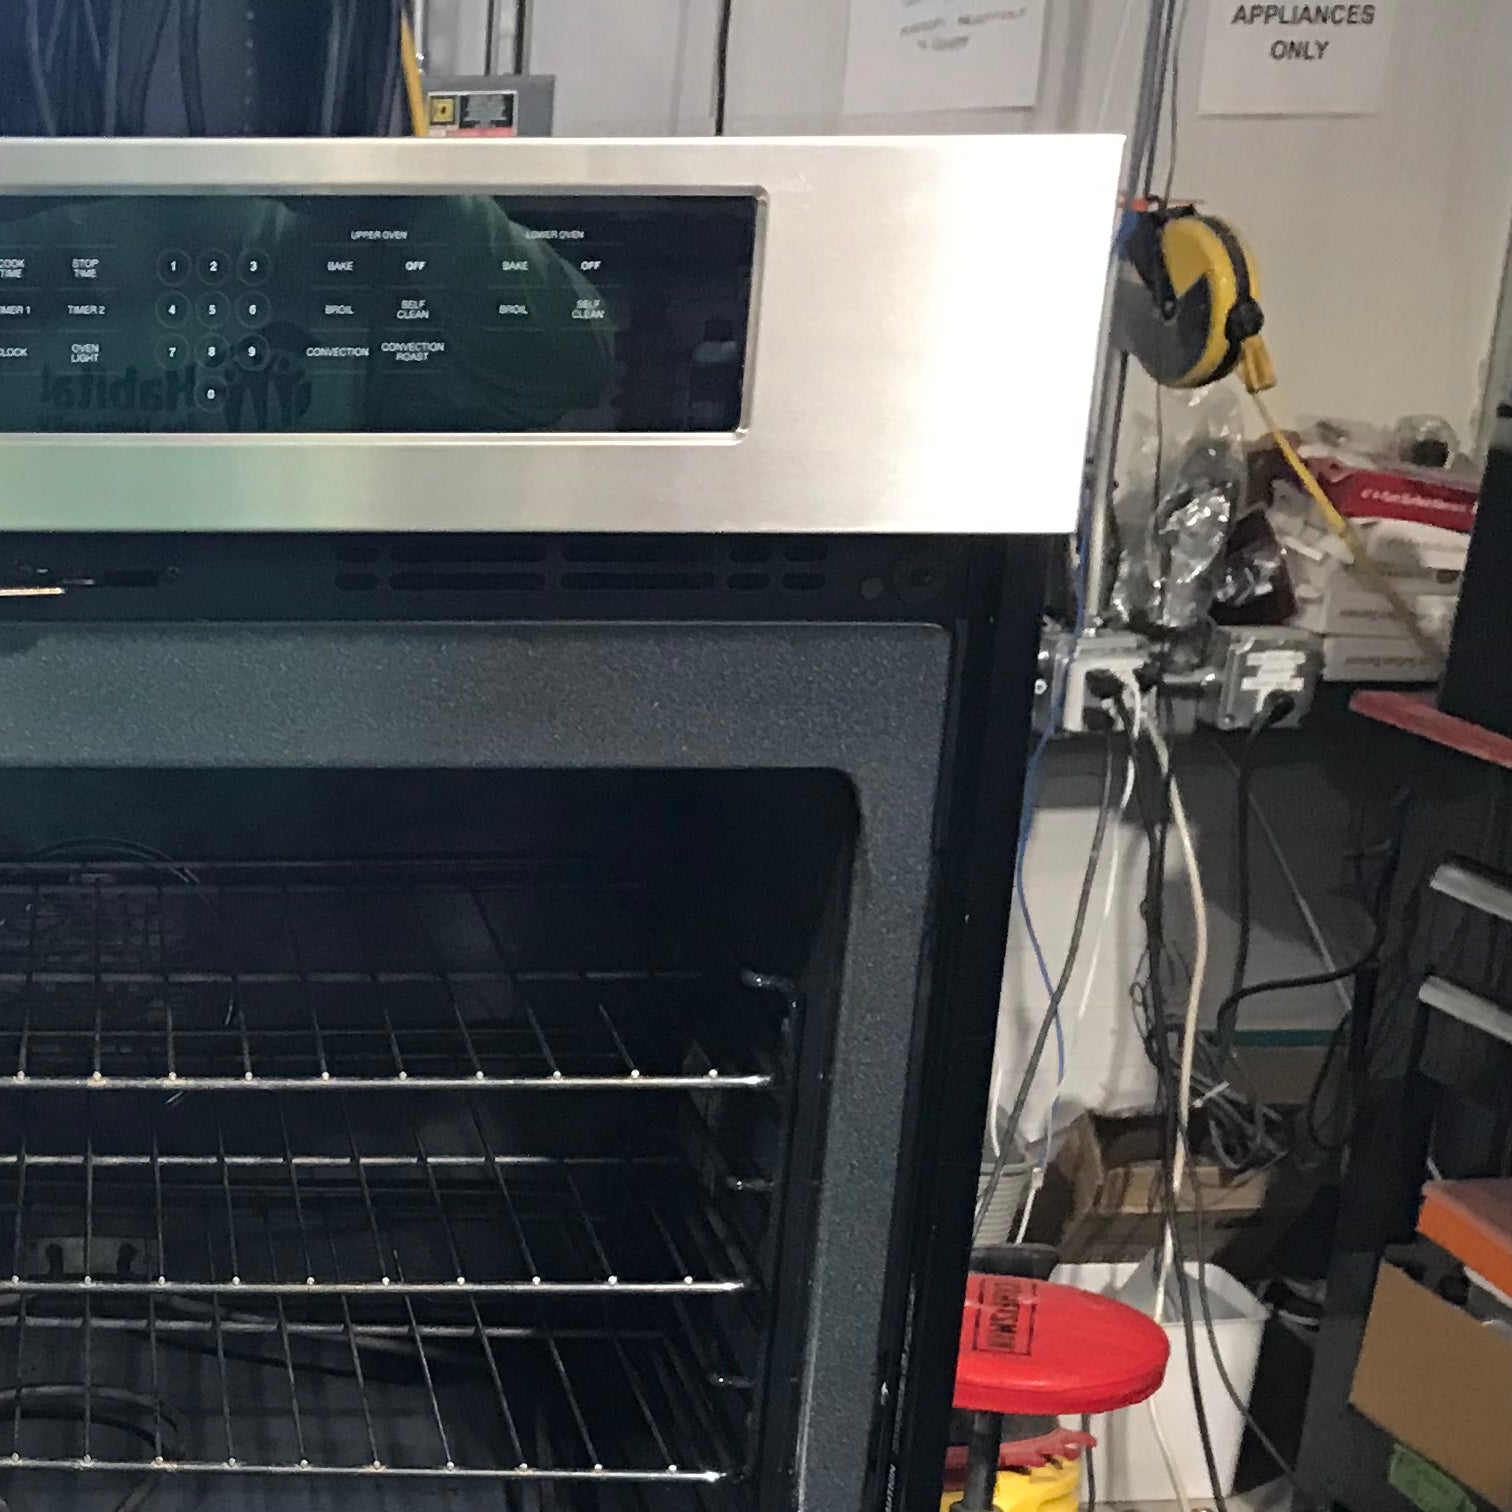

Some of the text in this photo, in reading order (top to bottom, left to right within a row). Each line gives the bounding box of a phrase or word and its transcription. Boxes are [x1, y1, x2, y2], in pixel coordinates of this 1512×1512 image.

[1231, 4, 1376, 25] APPLIANCES
[1270, 40, 1330, 60] ONLY
[350, 229, 408, 241] UPPER OVEN
[524, 229, 585, 241] LOWER OVEN
[71, 258, 100, 269] STOP
[327, 260, 354, 271] BAKE
[405, 260, 426, 271] OFF
[502, 260, 529, 271] BAKE
[580, 260, 602, 271] OFF
[0, 268, 23, 279] TIME
[73, 268, 98, 279] TIME
[67, 304, 98, 315] TIMER
[324, 304, 355, 315] BROIL
[400, 299, 426, 310] SELF
[498, 304, 529, 315] BROIL
[576, 299, 601, 310] SELF
[396, 309, 430, 320] CLEAN
[571, 308, 605, 320] CLEAN
[71, 343, 100, 354] OVEN
[305, 346, 370, 357] CONVECTION
[380, 341, 445, 352] CONVECTION
[70, 353, 99, 363] LIGHT
[395, 351, 429, 362] ROAST
